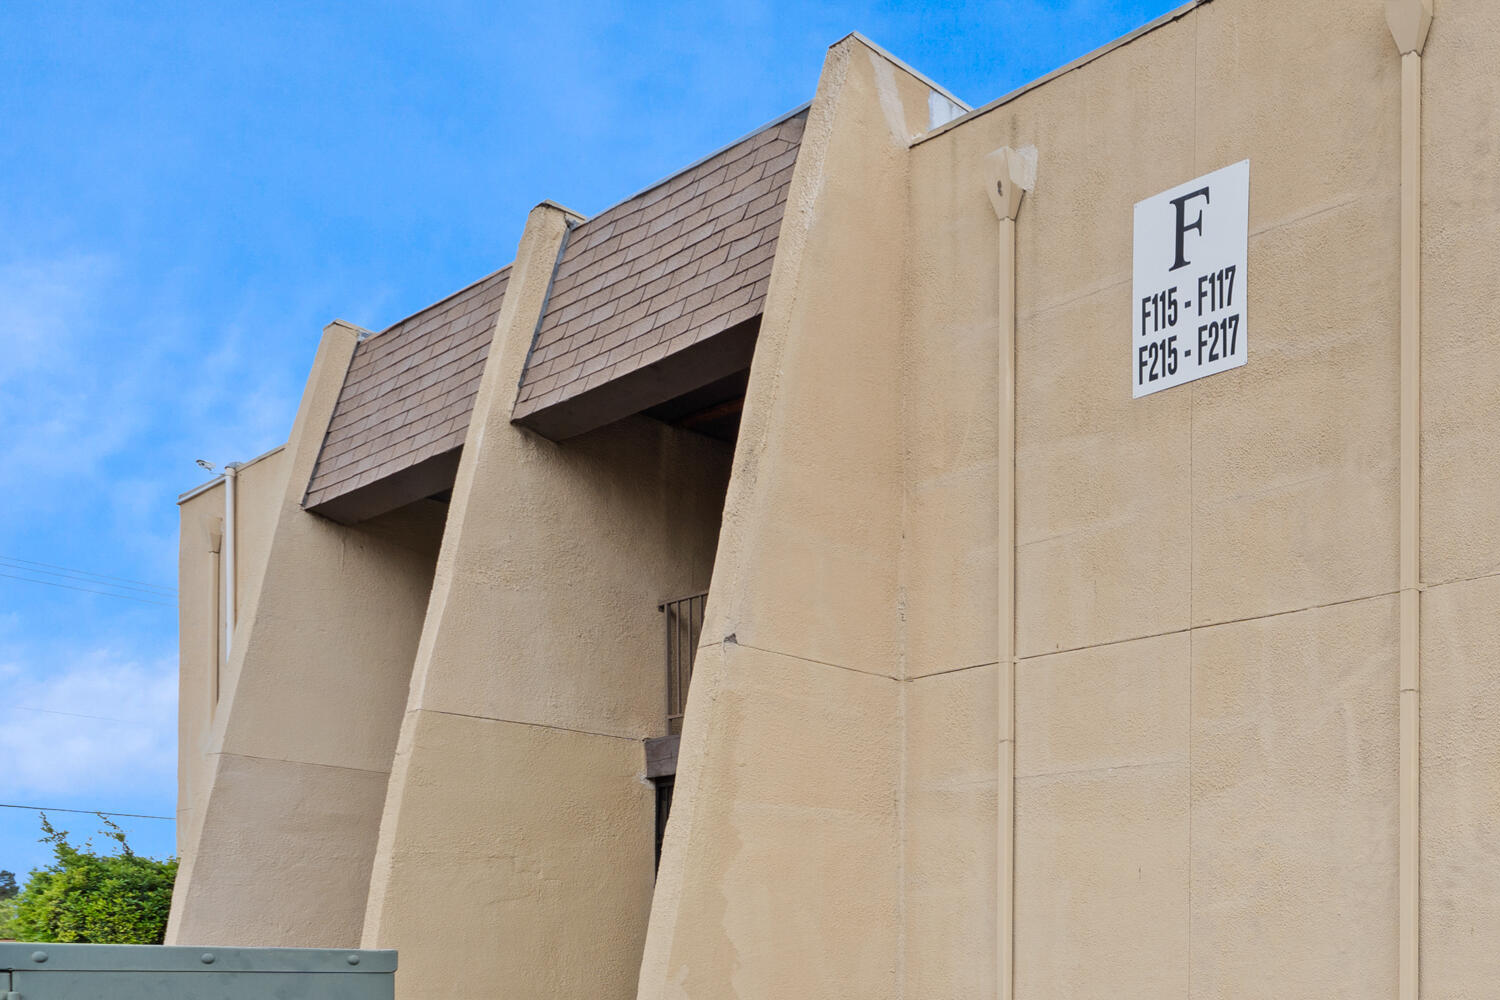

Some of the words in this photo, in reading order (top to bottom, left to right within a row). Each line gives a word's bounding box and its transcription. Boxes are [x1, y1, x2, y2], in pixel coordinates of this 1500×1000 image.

[1168, 186, 1210, 272] F
[1141, 286, 1178, 336] F115
[1197, 264, 1237, 316] F117
[1138, 335, 1178, 385] F215
[1197, 313, 1240, 366] F217
